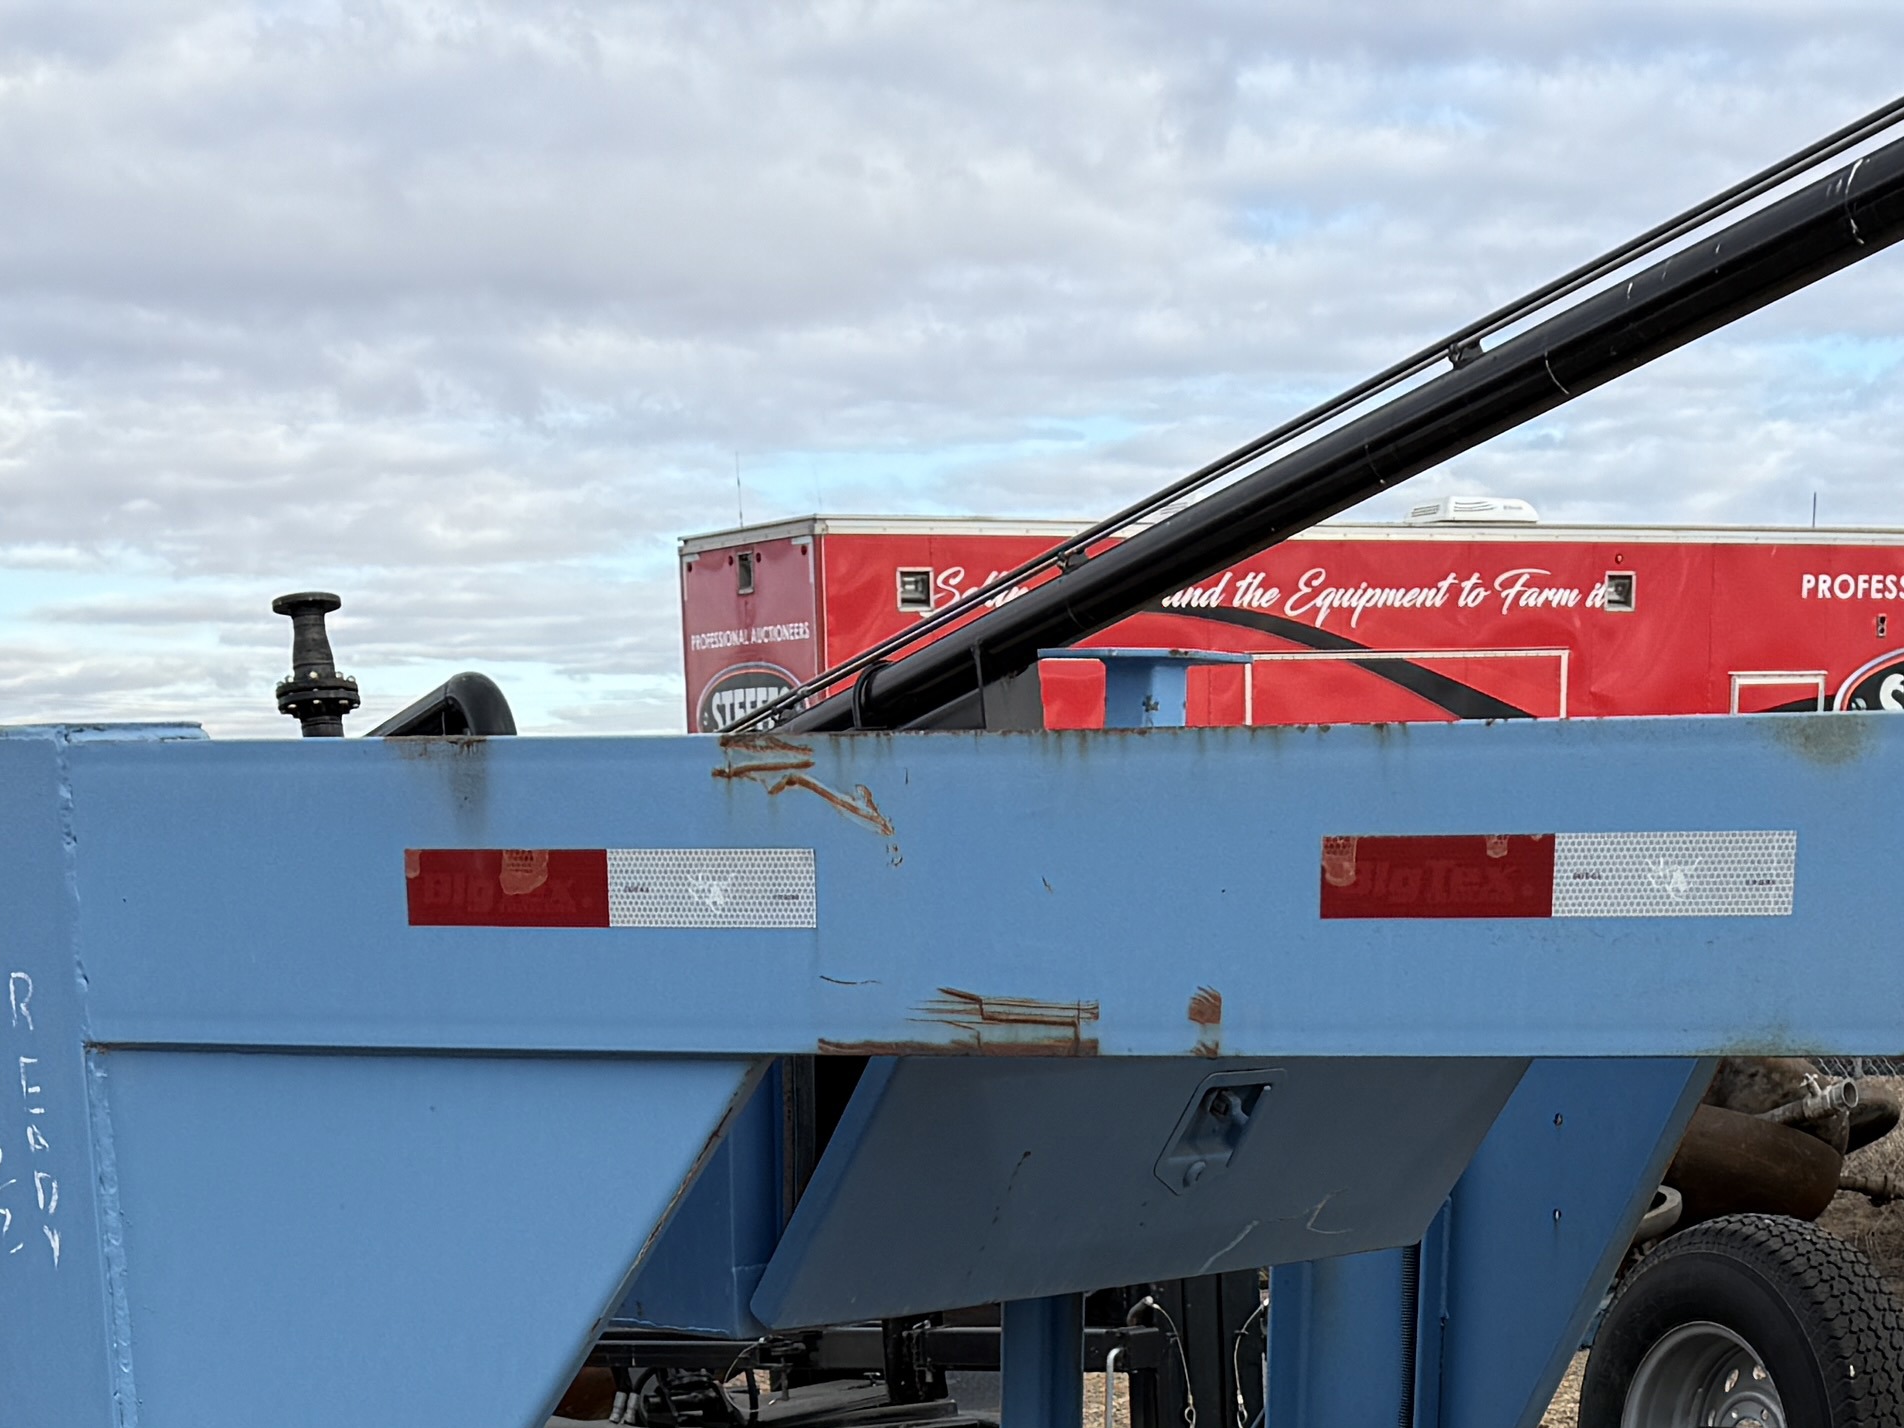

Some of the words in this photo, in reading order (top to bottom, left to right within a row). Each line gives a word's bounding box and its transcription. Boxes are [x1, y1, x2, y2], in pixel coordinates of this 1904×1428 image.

[1232, 571, 1281, 608] the
[1284, 567, 1459, 628] Equipment
[1456, 572, 1490, 608] to
[1494, 567, 1581, 615] Farm
[691, 629, 749, 651] PROFESSIONAL
[750, 622, 810, 644] AUCTIONEERS
